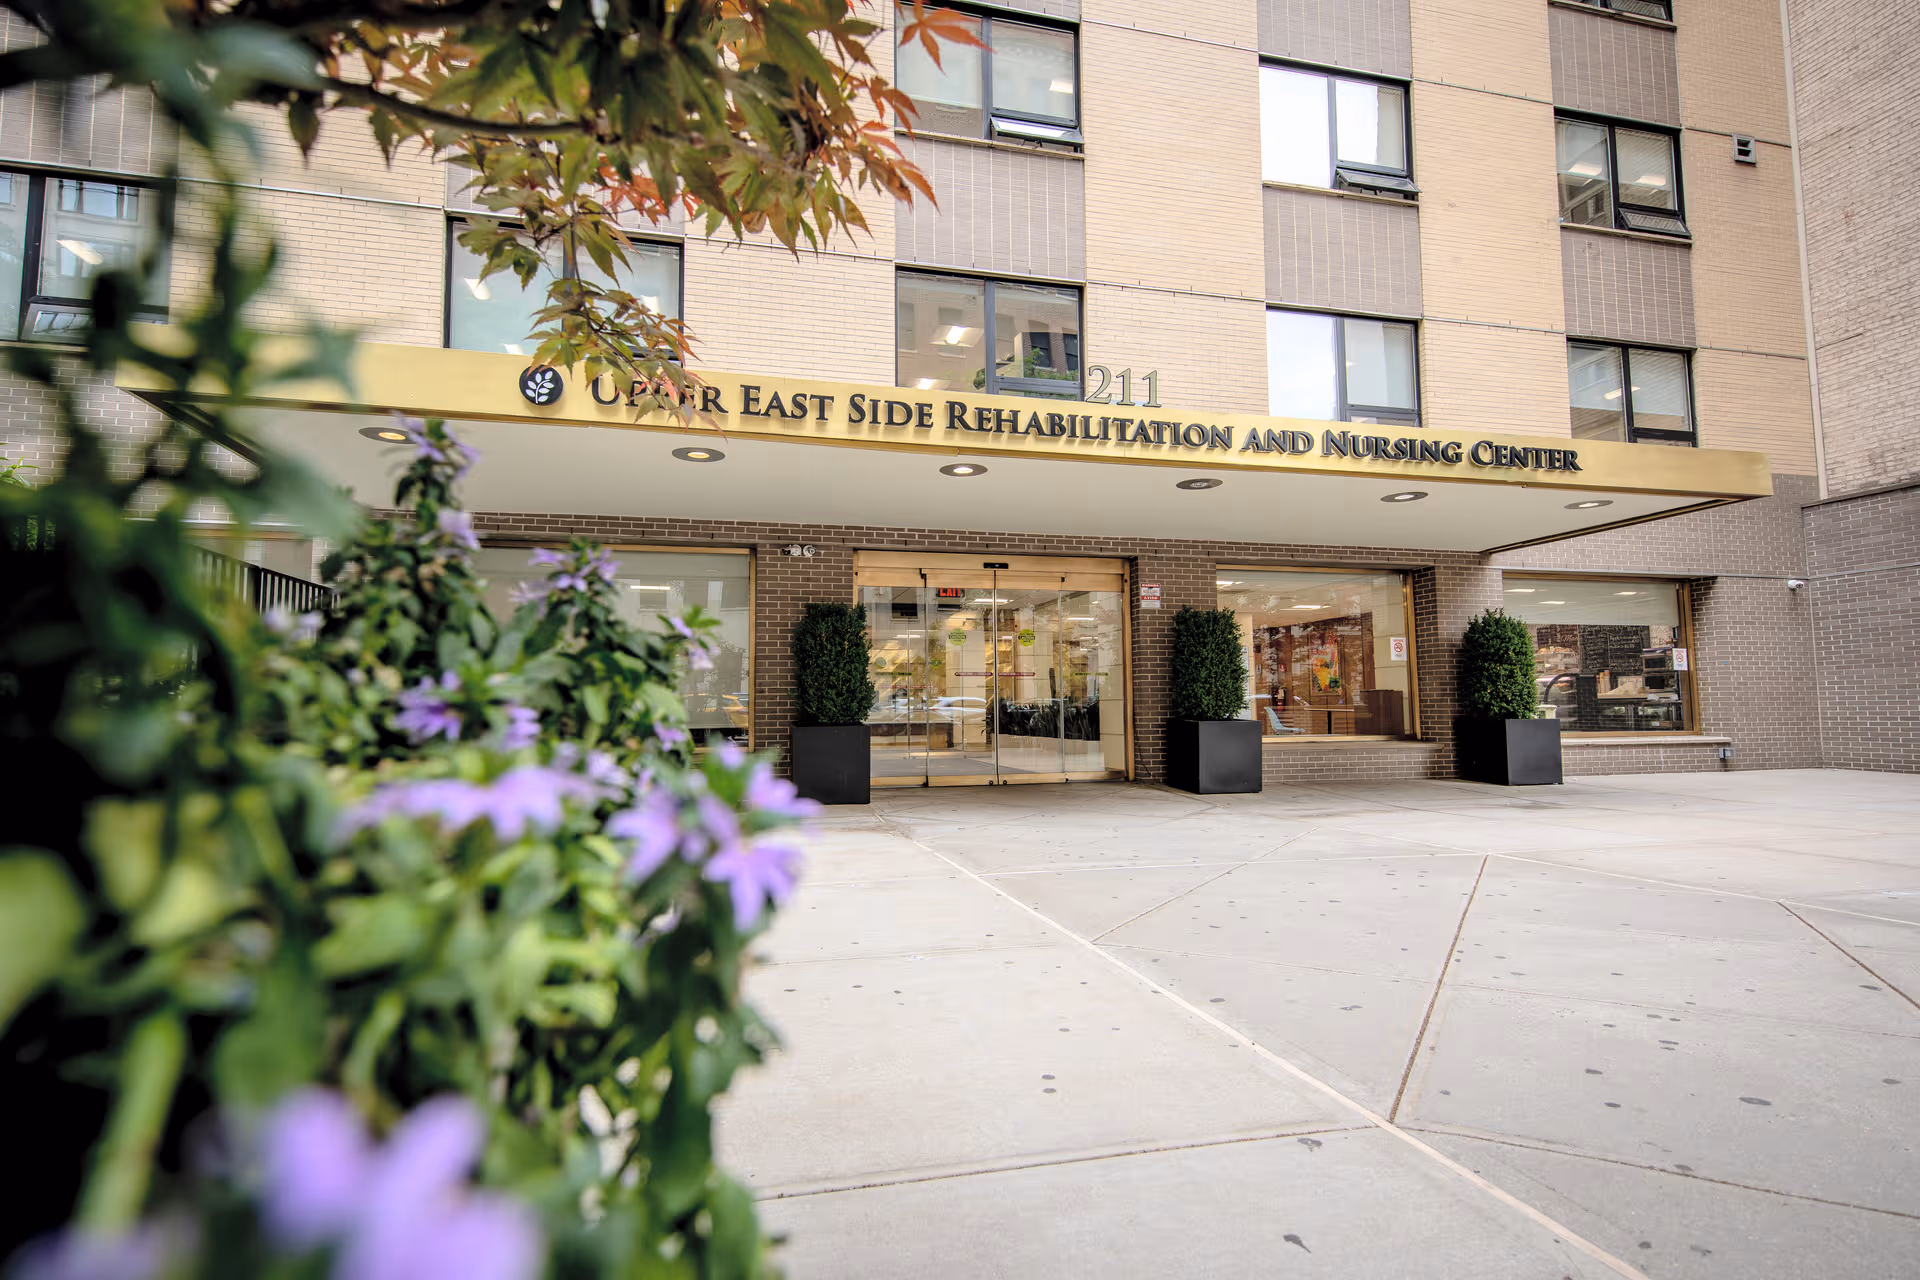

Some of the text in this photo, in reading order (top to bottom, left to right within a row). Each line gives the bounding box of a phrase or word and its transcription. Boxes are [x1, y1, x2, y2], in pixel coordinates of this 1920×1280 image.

[1085, 365, 1162, 408] 211
[739, 384, 834, 421] EAST
[848, 393, 934, 429] SIDE
[944, 400, 1234, 450] REHABILITATION
[1240, 427, 1315, 456] AND
[1321, 430, 1464, 465] NURSING
[1471, 440, 1582, 472] CENTER
